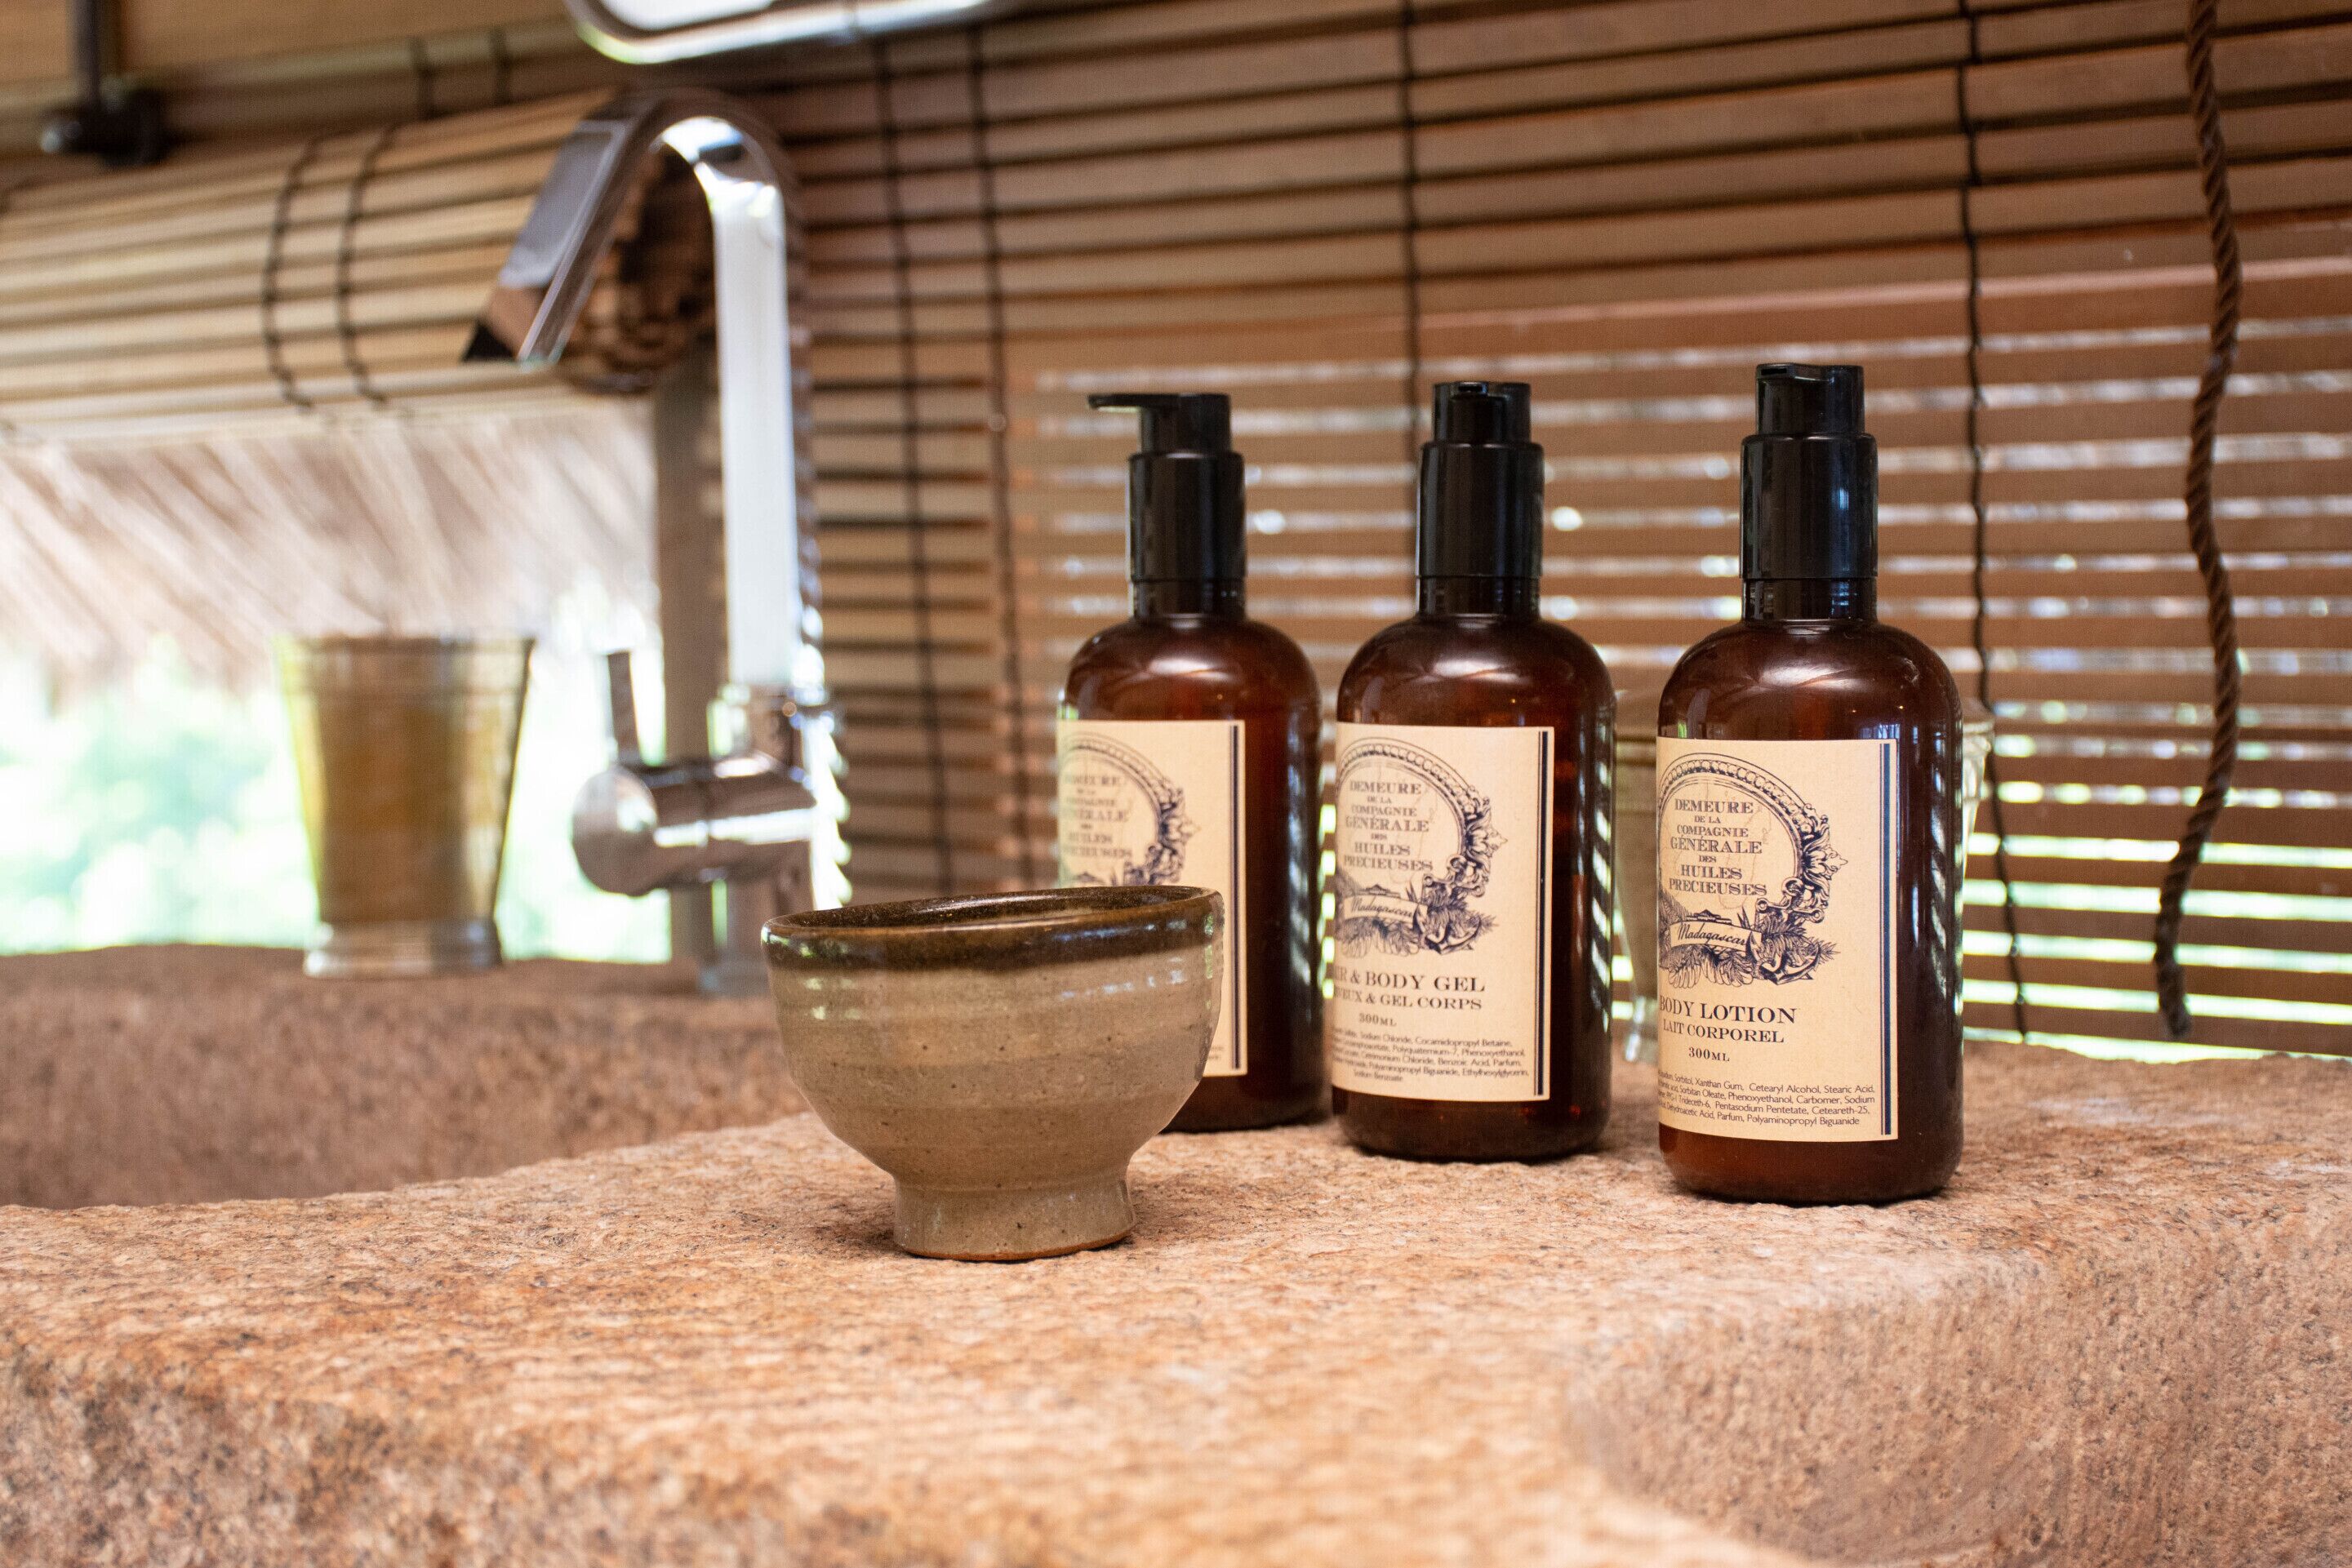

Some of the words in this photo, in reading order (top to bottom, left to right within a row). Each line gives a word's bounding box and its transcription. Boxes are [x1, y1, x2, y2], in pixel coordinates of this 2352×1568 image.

[1350, 780, 1422, 795] DEMEURE
[1351, 805, 1417, 817] COMPAGNIE
[1674, 798, 1754, 815] DEMEURE
[1694, 815, 1705, 824] DE
[1677, 824, 1749, 838] COMPAGNIE
[1354, 842, 1412, 856] HUILES
[1670, 834, 1763, 855] GÉNÉRALE
[1699, 855, 1717, 864] DES
[1680, 864, 1743, 881] HUILES
[1669, 877, 1767, 897] PRECIEUSES
[1350, 969, 1360, 984] &
[1366, 971, 1425, 990] BODY
[1434, 975, 1485, 993] GEL
[1366, 992, 1376, 1004] &
[1380, 993, 1413, 1008] GEL
[1417, 997, 1483, 1011] CORPS
[1660, 995, 1695, 1018] BODY
[1700, 1002, 1797, 1024] LOTION
[1358, 1013, 1398, 1027] 300ML
[1663, 1019, 1685, 1035] LAIT
[1687, 1024, 1785, 1044] CORPOREL
[1415, 1036, 1480, 1048] Cocamidopropyl
[1688, 1046, 1730, 1062] 300ML
[1696, 1077, 1722, 1089] Xanthan
[1723, 1081, 1745, 1091] Gum,
[1749, 1082, 1784, 1094] Cetearyl
[1786, 1085, 1821, 1094] Alcohol,
[1824, 1084, 1852, 1094] Stearic
[1854, 1084, 1875, 1094] Acid,
[1702, 1089, 1727, 1100] Oleate,
[1728, 1091, 1794, 1104] Phenoxyethanol,
[1796, 1095, 1843, 1104] Carbomer,
[1844, 1095, 1875, 1104] Sodium
[1715, 1100, 1763, 1113] Pentasodium
[1766, 1104, 1809, 1115] Pentetate,
[1812, 1105, 1870, 1115] Ceteareth-25,
[1699, 1109, 1715, 1119] Acid,
[1717, 1111, 1745, 1122] Parfum,
[1747, 1114, 1817, 1126] Polyaminopropyl
[1819, 1117, 1860, 1127] Biguanide
